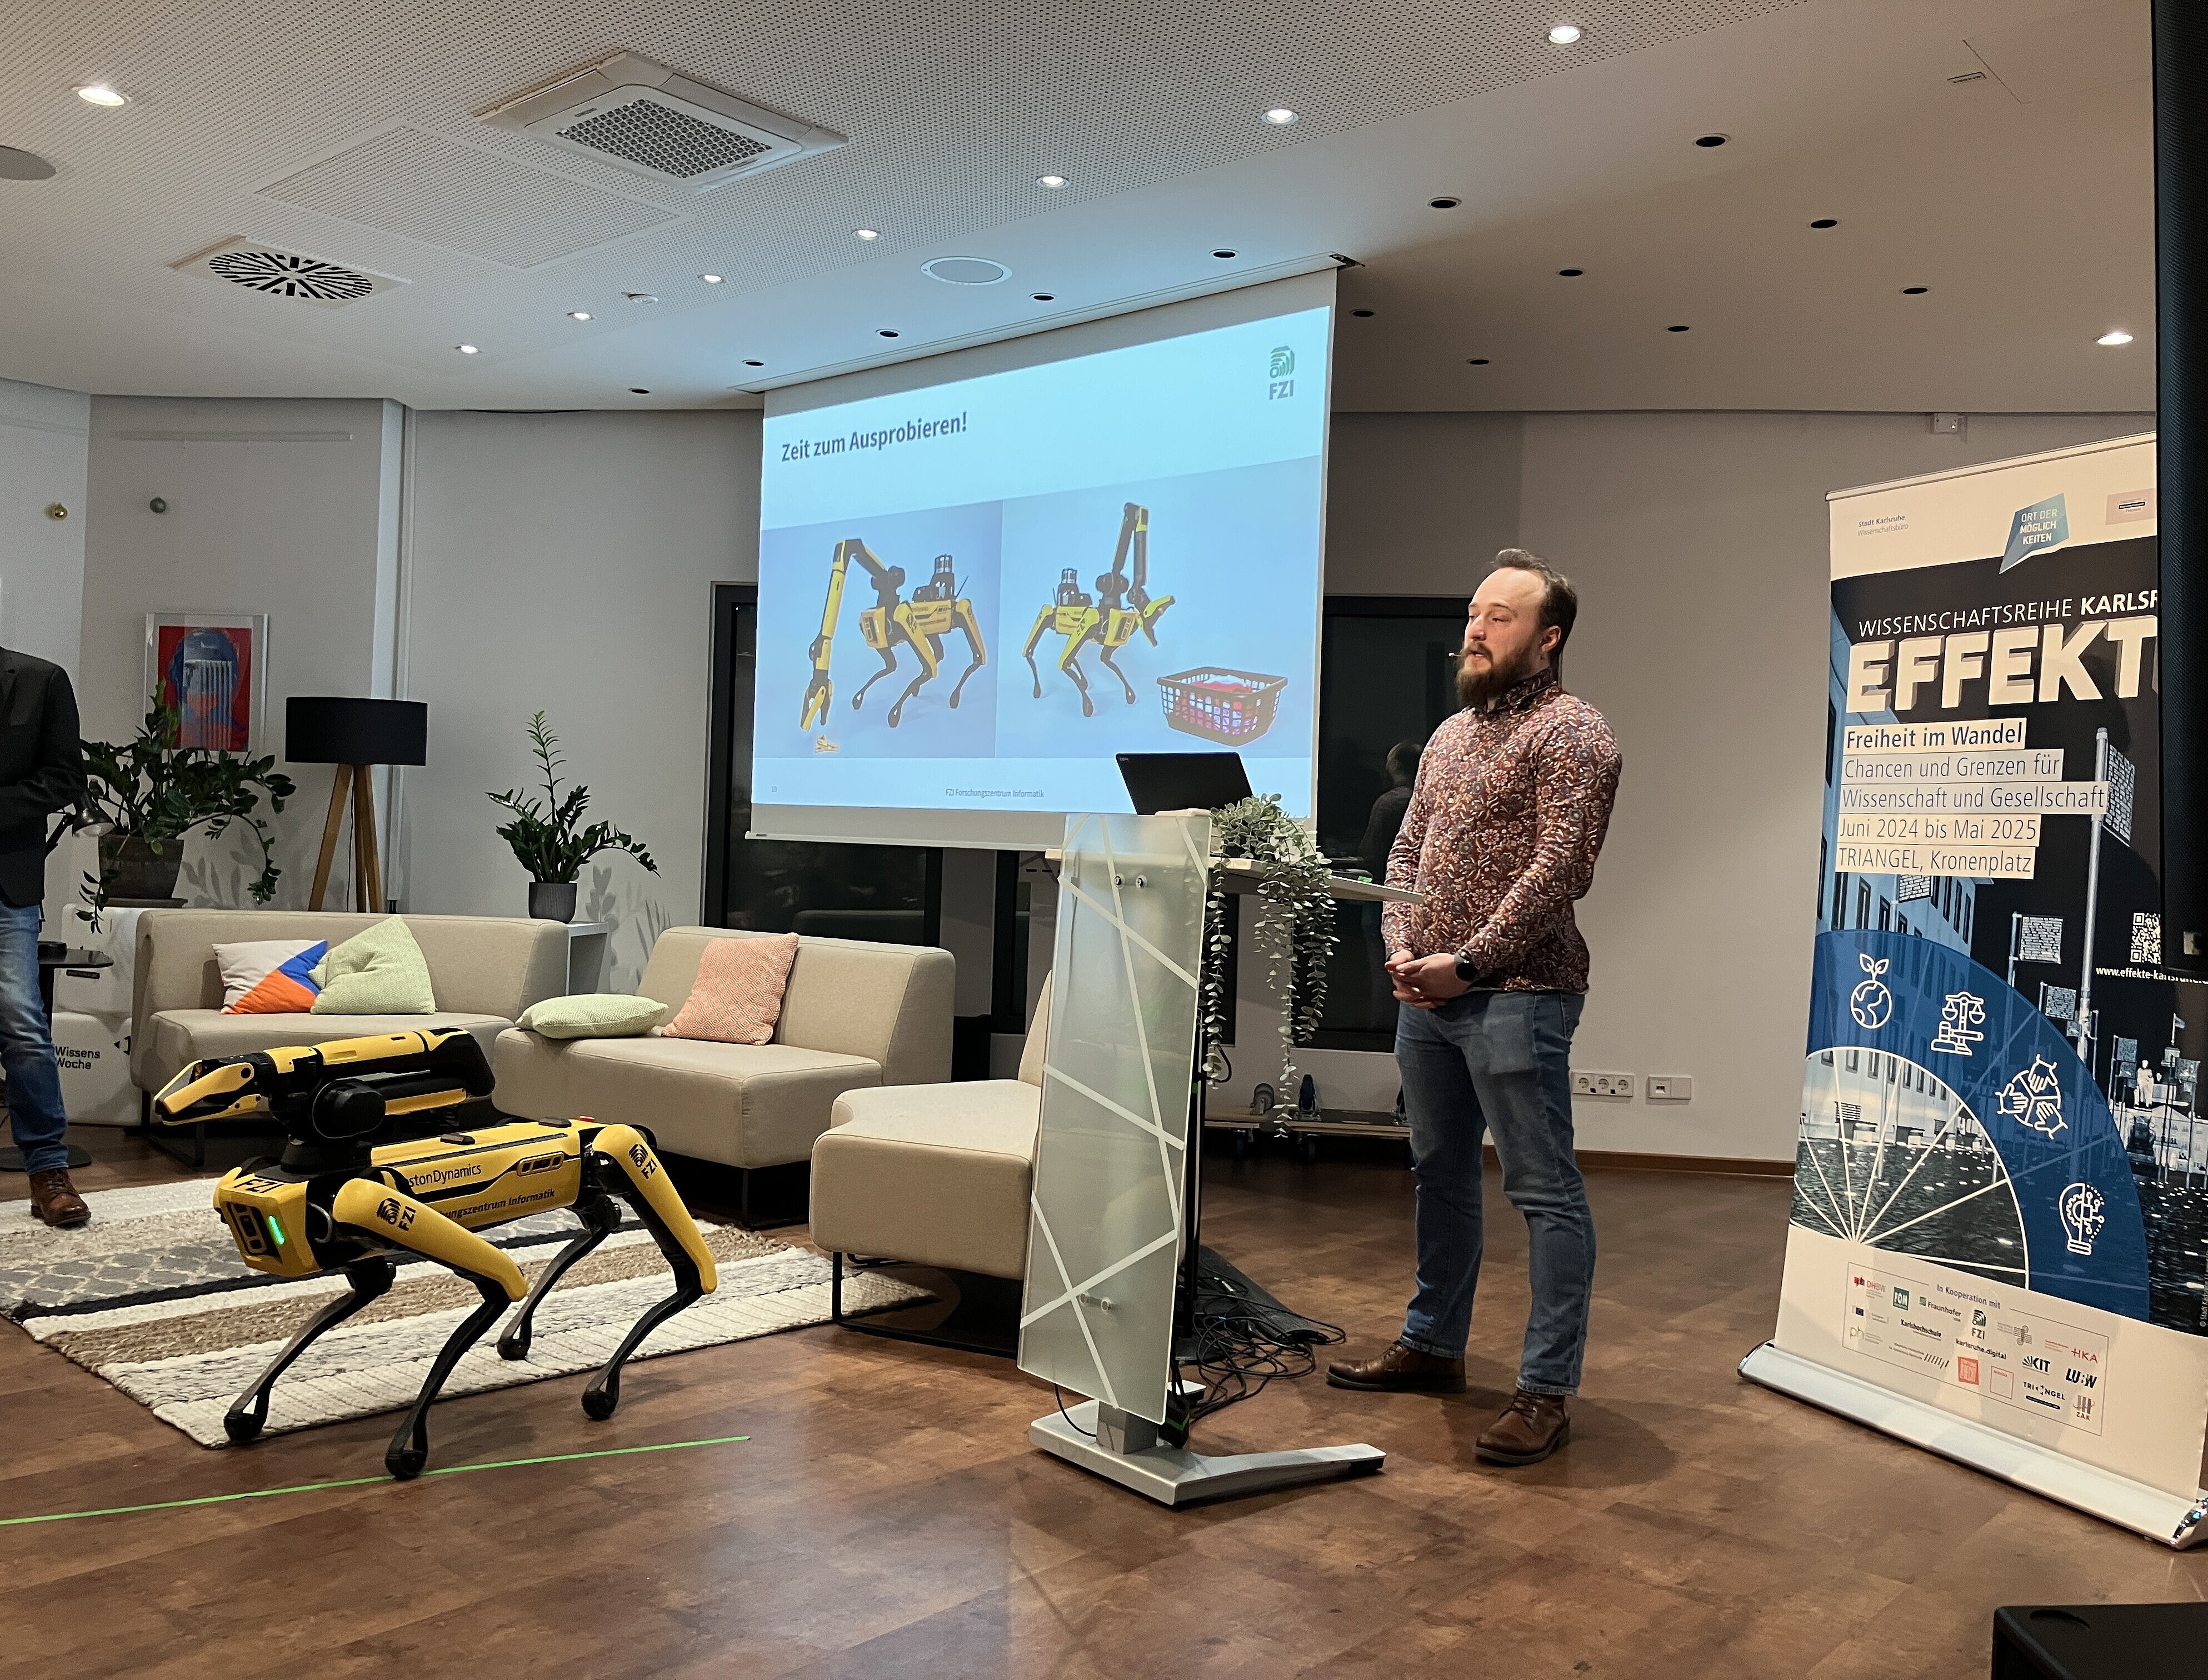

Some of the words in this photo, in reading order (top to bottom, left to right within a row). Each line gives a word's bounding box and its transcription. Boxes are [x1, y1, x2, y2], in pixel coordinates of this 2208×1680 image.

[1269, 379, 1294, 401] FZI
[781, 439, 810, 462] Zeit
[813, 437, 846, 457] zum
[848, 411, 967, 451] Ausprobieren!
[1858, 519, 1874, 527] Stadt
[1875, 514, 1905, 524] Karlsruhe
[2021, 511, 2037, 523] ORT
[2040, 508, 2058, 521] DER
[2019, 520, 2056, 534] MÖGLICH
[2022, 532, 2052, 545] KEITEN
[1859, 598, 2073, 637] WISSENSCHAFTSREIHE
[1846, 614, 2158, 713] EFFEKT
[1847, 728, 1916, 749] Freiheit
[1922, 727, 1945, 747] im
[1951, 722, 2022, 746] Wandel
[1845, 758, 1912, 778] Chancen
[1920, 756, 1950, 777] und
[1957, 757, 2026, 777] Grenzen
[2034, 753, 2060, 774] für
[955, 789, 1012, 799] Forschungszentrum
[1842, 787, 1947, 808] Wissenschaft
[1954, 787, 1984, 807] und
[1991, 785, 2105, 807] Gesellschaft
[1840, 818, 1870, 837] Juni
[1876, 819, 1919, 838] 2024
[1925, 818, 1947, 839] bis
[1954, 819, 1984, 839] Mai
[1991, 819, 2036, 840] 2025
[1839, 847, 1923, 873] TRIANGEL,
[1931, 850, 2031, 877] Kronenplatz
[55, 1046, 101, 1059] Wissens
[641, 1158, 657, 1180] FZI
[232, 1178, 284, 1193] FZI
[508, 1188, 556, 1207] Informatik
[397, 1206, 416, 1232] FZI
[1937, 1284, 1944, 1292] In
[1946, 1287, 1987, 1305] Kooperation
[1989, 1300, 2001, 1309] mit
[1927, 1301, 1961, 1317] Fraunhofer
[1972, 1327, 1985, 1340] FZI
[1956, 1338, 2007, 1360] karlsruhe.digital
[2071, 1348, 2098, 1364] HKA
[2030, 1356, 2051, 1372] KIT
[2076, 1411, 2090, 1421] ZAK
